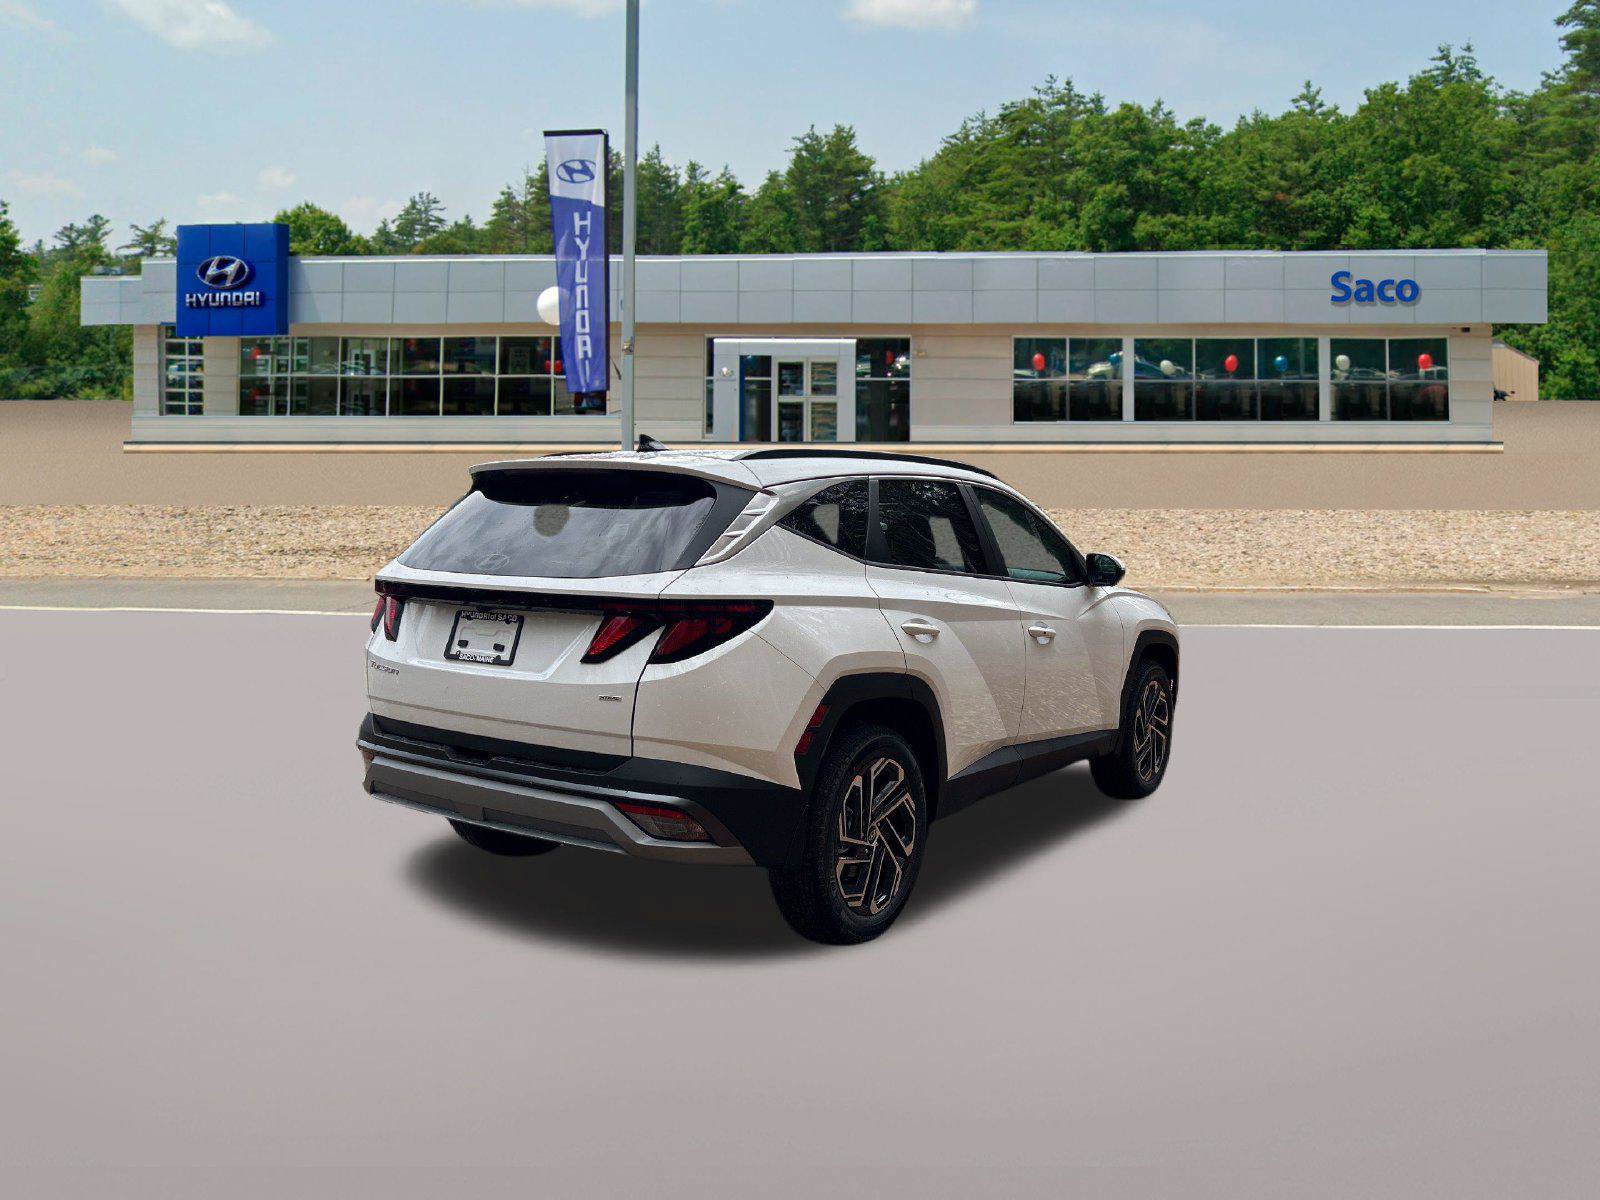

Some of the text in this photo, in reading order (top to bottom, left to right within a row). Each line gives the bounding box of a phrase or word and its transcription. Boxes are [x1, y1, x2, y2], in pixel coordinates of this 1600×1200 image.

[185, 291, 260, 307] HYUNDAI
[573, 211, 592, 384] HYUNDAI
[1330, 271, 1420, 303] Saco
